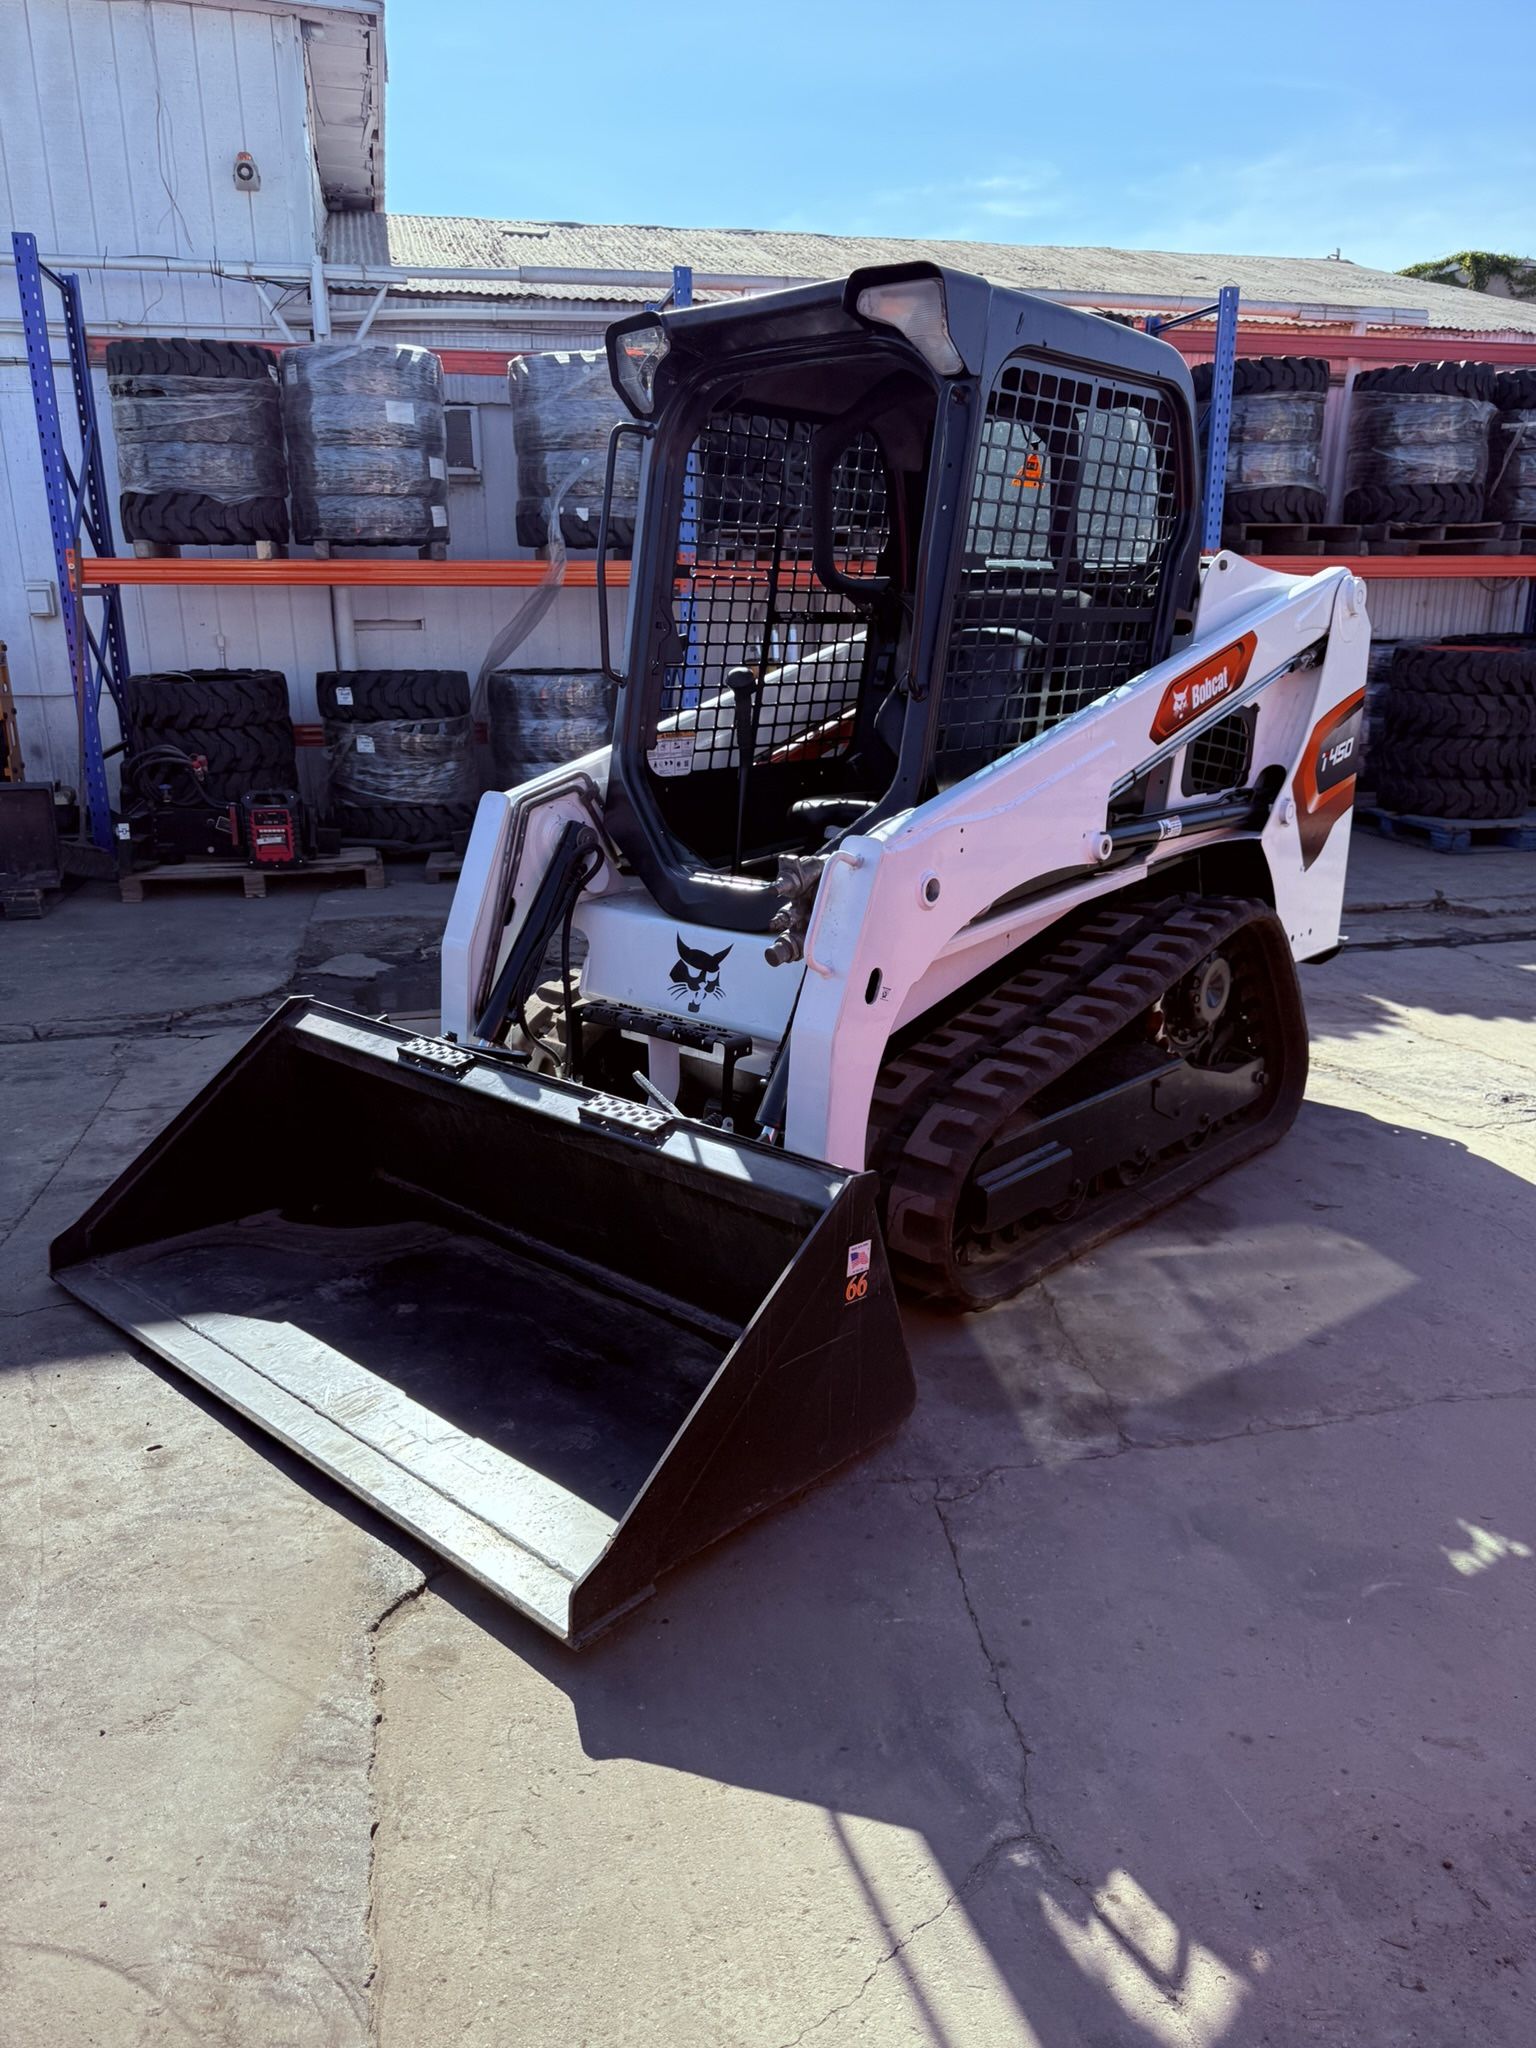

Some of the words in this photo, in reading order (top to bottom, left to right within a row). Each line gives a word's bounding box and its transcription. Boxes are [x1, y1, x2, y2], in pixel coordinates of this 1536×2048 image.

[1191, 666, 1228, 709] Bobcat
[1321, 736, 1354, 772] T450
[845, 1271, 868, 1301] 66
